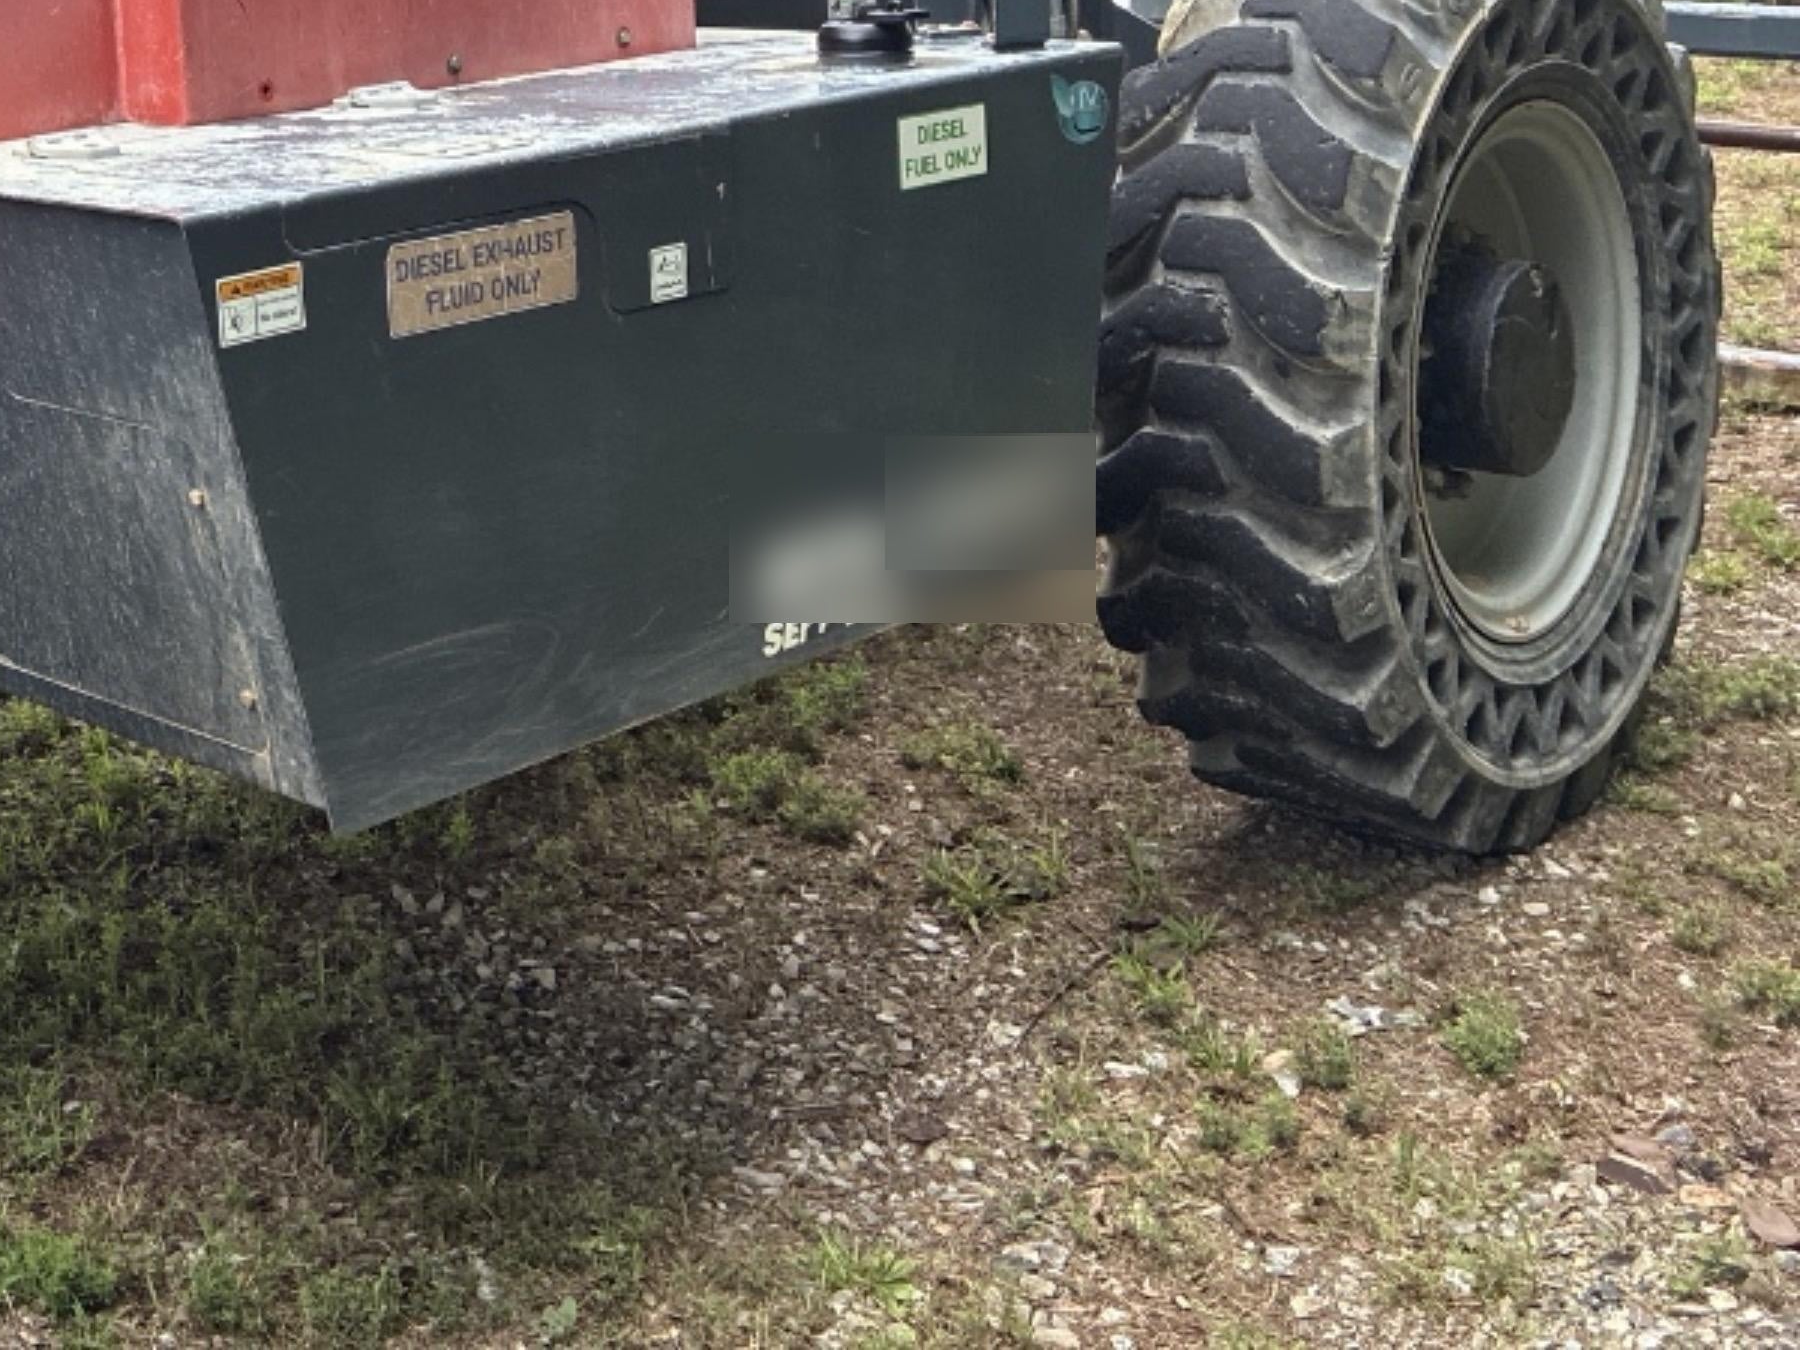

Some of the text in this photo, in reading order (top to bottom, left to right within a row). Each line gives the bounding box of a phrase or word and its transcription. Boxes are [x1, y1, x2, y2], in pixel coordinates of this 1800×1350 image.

[917, 118, 968, 146] DIESEL
[904, 143, 982, 180] FUEL ONLY
[394, 226, 566, 283] DIESEL EXHAUST
[425, 266, 541, 315] FLUID ONLY
